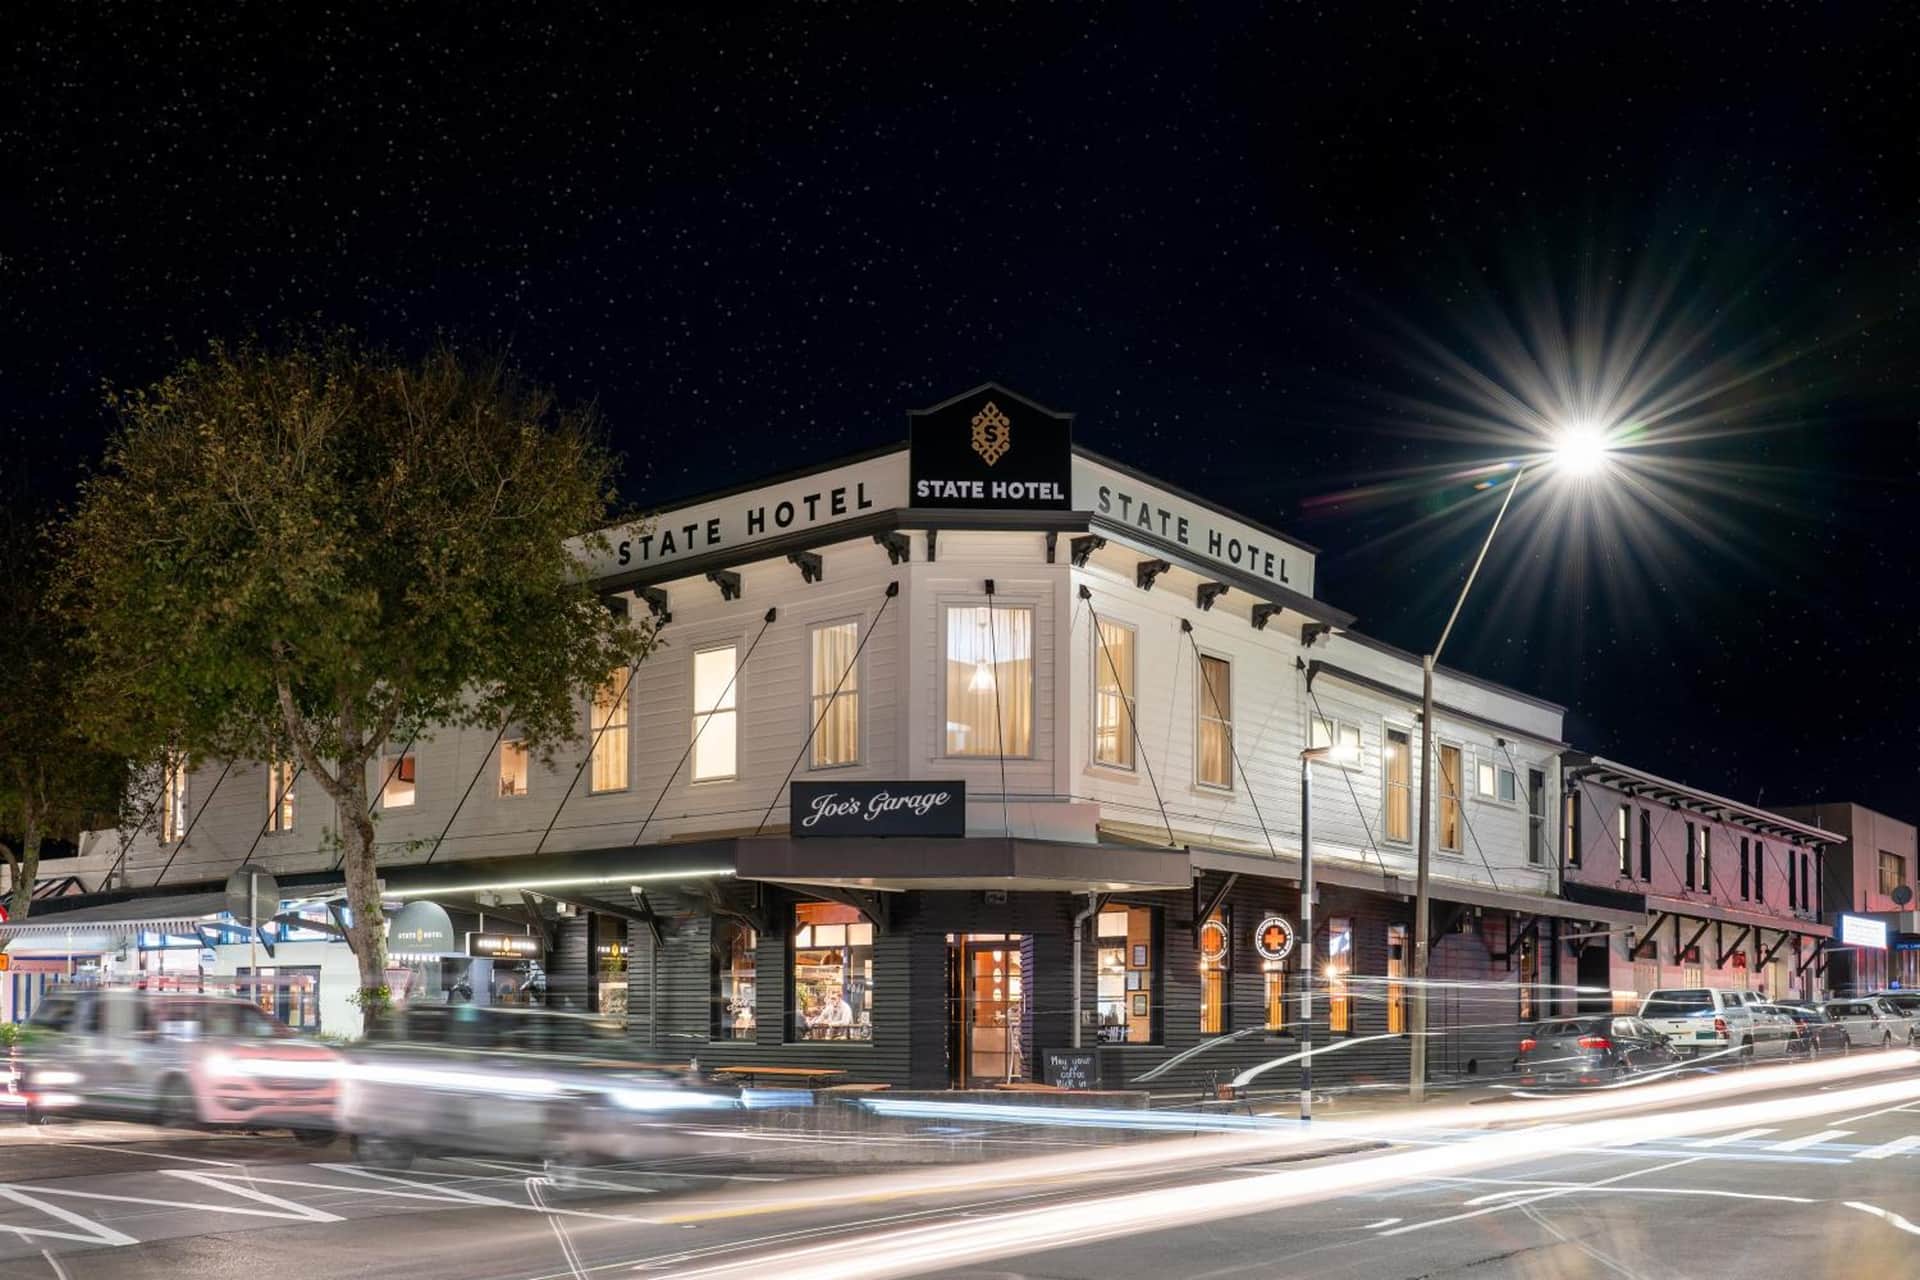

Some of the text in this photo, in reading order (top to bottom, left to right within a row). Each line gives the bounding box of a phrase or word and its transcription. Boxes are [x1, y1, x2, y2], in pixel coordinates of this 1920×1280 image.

[983, 424, 998, 444] S
[917, 480, 1064, 500] STATE HOTEL
[618, 482, 872, 566] STATE HOTEL
[1098, 485, 1290, 584] STATE HOTEL
[802, 791, 950, 827] Joe's Garage
